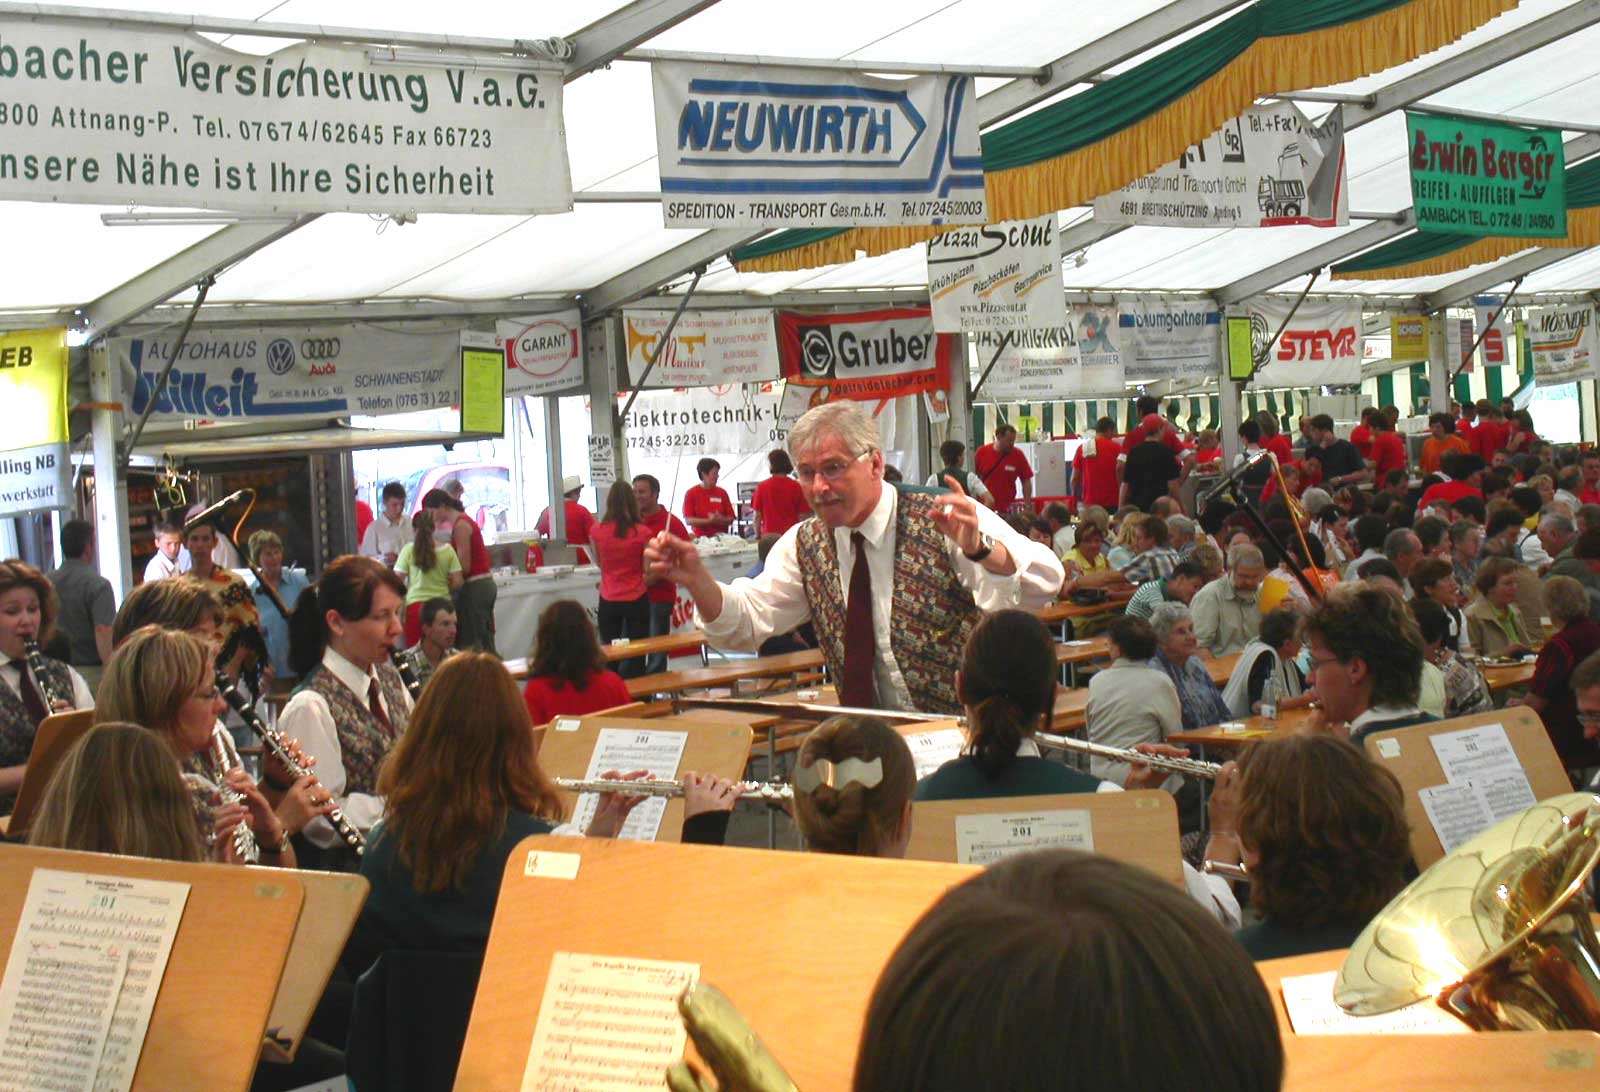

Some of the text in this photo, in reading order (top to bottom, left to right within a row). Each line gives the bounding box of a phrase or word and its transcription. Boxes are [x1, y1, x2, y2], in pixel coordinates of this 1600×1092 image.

[0, 37, 546, 114] bacher Versicherung V.a.G.
[51, 105, 178, 137] Attnang-P.
[193, 114, 231, 139] Tel.
[239, 120, 384, 145] 07674/62645
[393, 126, 427, 147] Fax
[433, 126, 492, 149] 66723
[677, 99, 892, 154] NEUWIRTH
[0, 151, 494, 196] nsere Nähe ist Ihre Sicherheit
[1413, 130, 1554, 190] Erwin Berger
[668, 202, 735, 219] SPEDITION
[749, 202, 828, 219] TRANSPORT
[902, 202, 917, 218] Tel.
[981, 218, 1052, 251] Scout
[1134, 309, 1205, 332] baumgartner
[148, 340, 256, 360] AUTOHAUS
[522, 334, 567, 352] GARANT
[838, 327, 932, 369] Gruber
[1277, 326, 1356, 361] STEYR
[309, 363, 336, 376] Audi
[358, 397, 392, 409] Telefon
[36, 454, 55, 469] NB
[1012, 826, 1032, 837] 201
